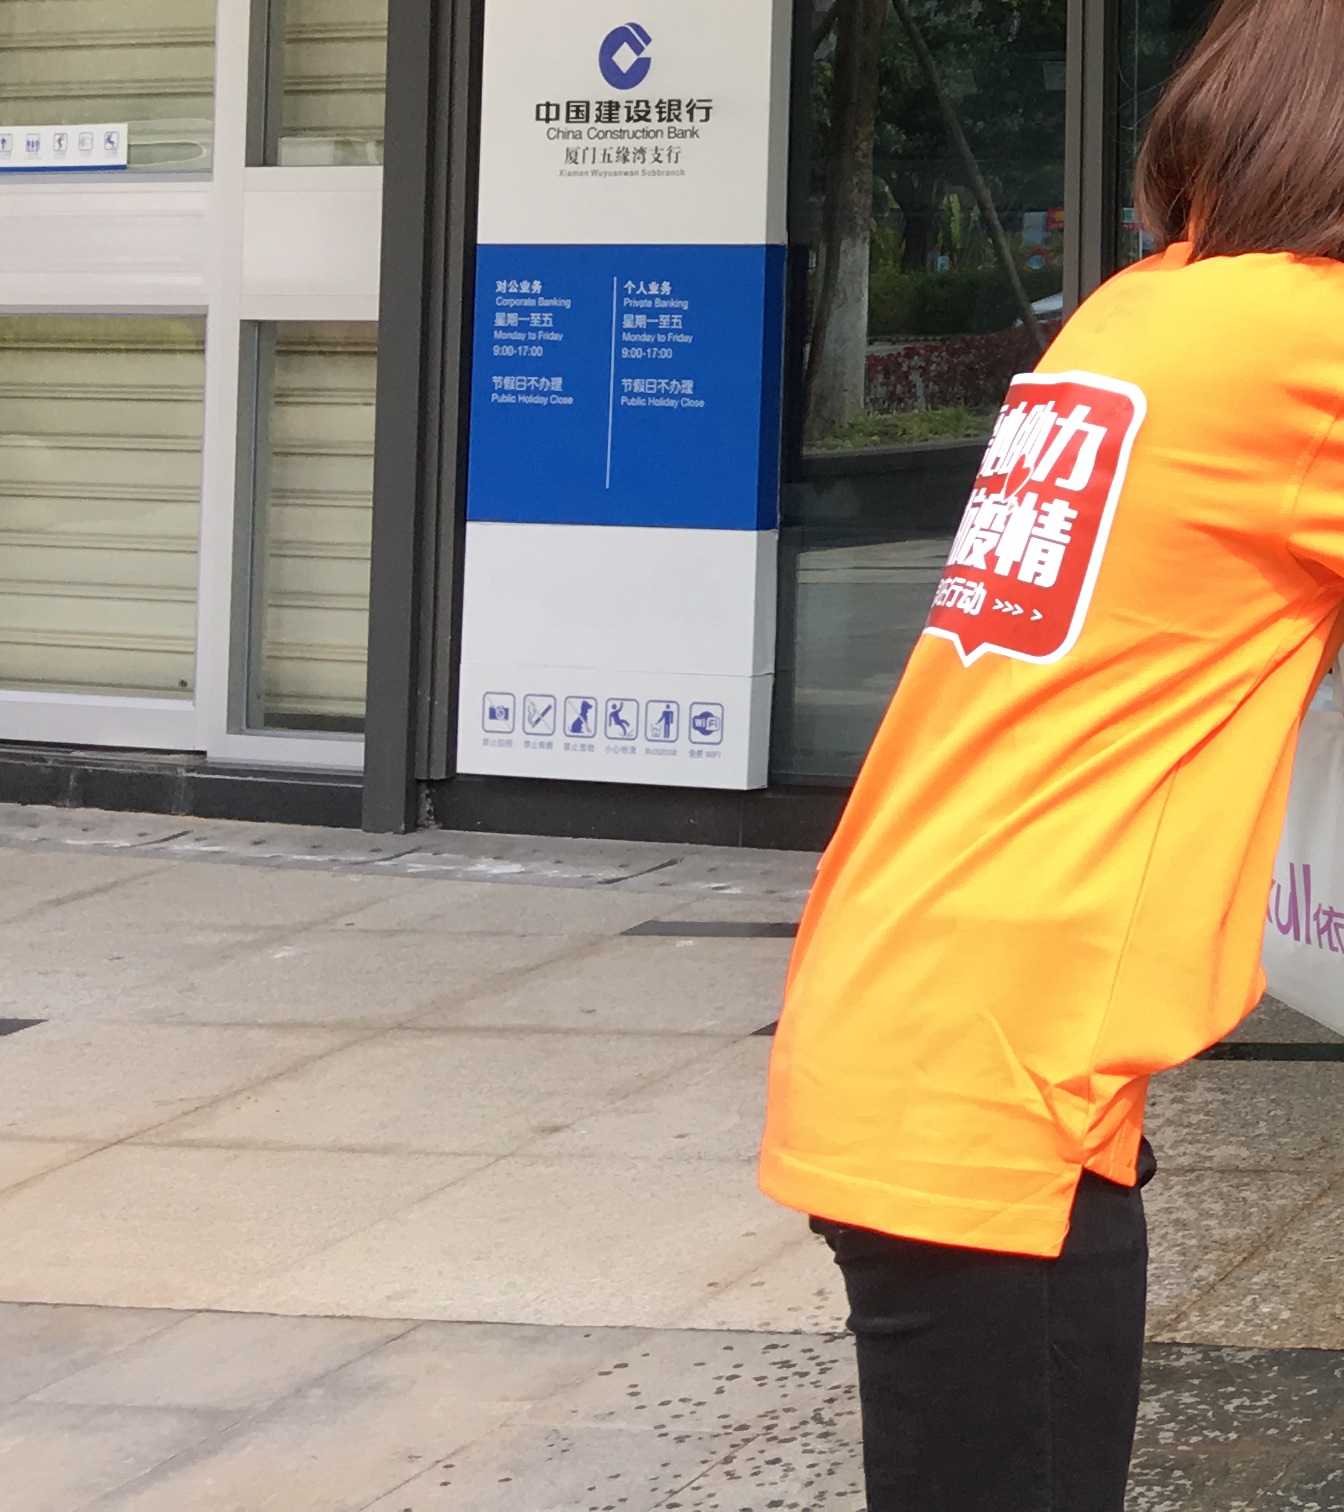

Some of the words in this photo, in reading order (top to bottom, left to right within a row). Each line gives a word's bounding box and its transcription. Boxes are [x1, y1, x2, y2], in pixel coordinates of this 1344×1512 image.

[535, 98, 713, 124] 中国建设银行
[546, 126, 583, 141] China
[586, 125, 664, 140] Construction
[667, 125, 700, 139] Bank
[564, 145, 682, 165] 厦门五缘湾支行
[495, 279, 542, 294] 对公业务
[623, 280, 672, 295] 个人业务
[537, 296, 572, 309] Banking
[623, 297, 653, 308] Private
[654, 297, 689, 310] Banking
[494, 312, 554, 328] 星期一至五
[622, 313, 683, 329] 星期一至五
[527, 330, 537, 340] to
[656, 333, 666, 342] to
[667, 332, 693, 344] Friday
[492, 344, 544, 357] 9:00-17:00
[621, 347, 673, 359] 9:00-17:00
[491, 375, 563, 392] 节假日不办理
[620, 378, 694, 395] 节假日不办理
[491, 392, 517, 403] Public
[517, 393, 549, 406] Holiday
[549, 394, 574, 405] Close
[620, 395, 647, 406] Public
[647, 396, 680, 409] Holiday
[680, 397, 705, 408] Close
